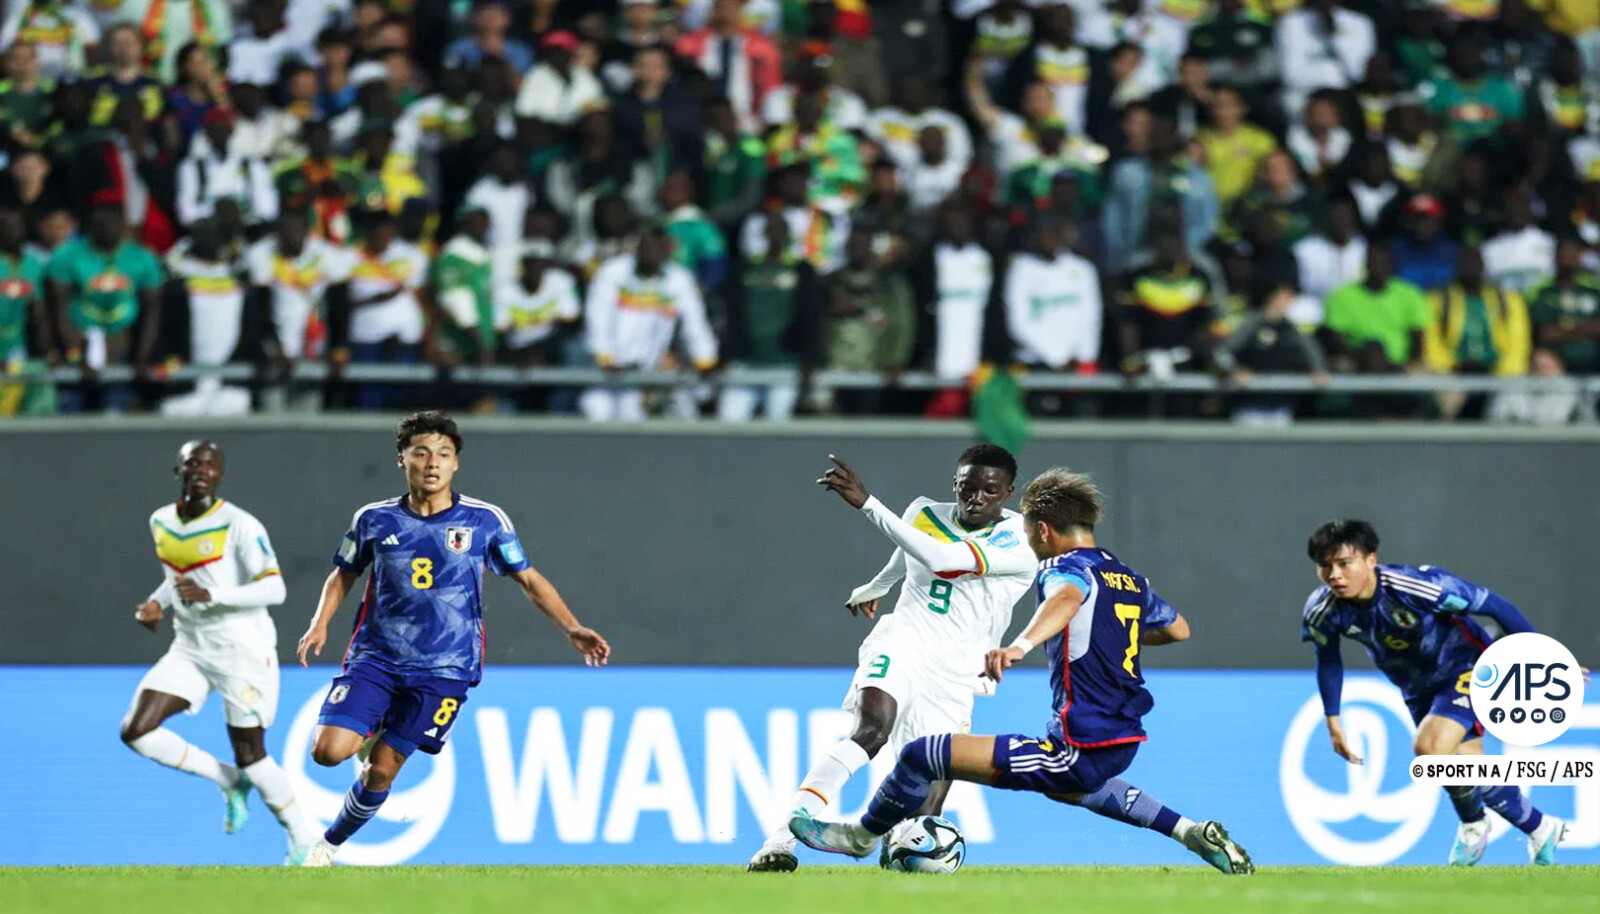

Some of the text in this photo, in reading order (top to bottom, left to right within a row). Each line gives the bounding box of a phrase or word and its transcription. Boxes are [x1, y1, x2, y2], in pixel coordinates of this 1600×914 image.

[411, 557, 434, 590] 8
[927, 578, 953, 615] 9
[1114, 602, 1141, 679] 7
[433, 697, 458, 726] 8
